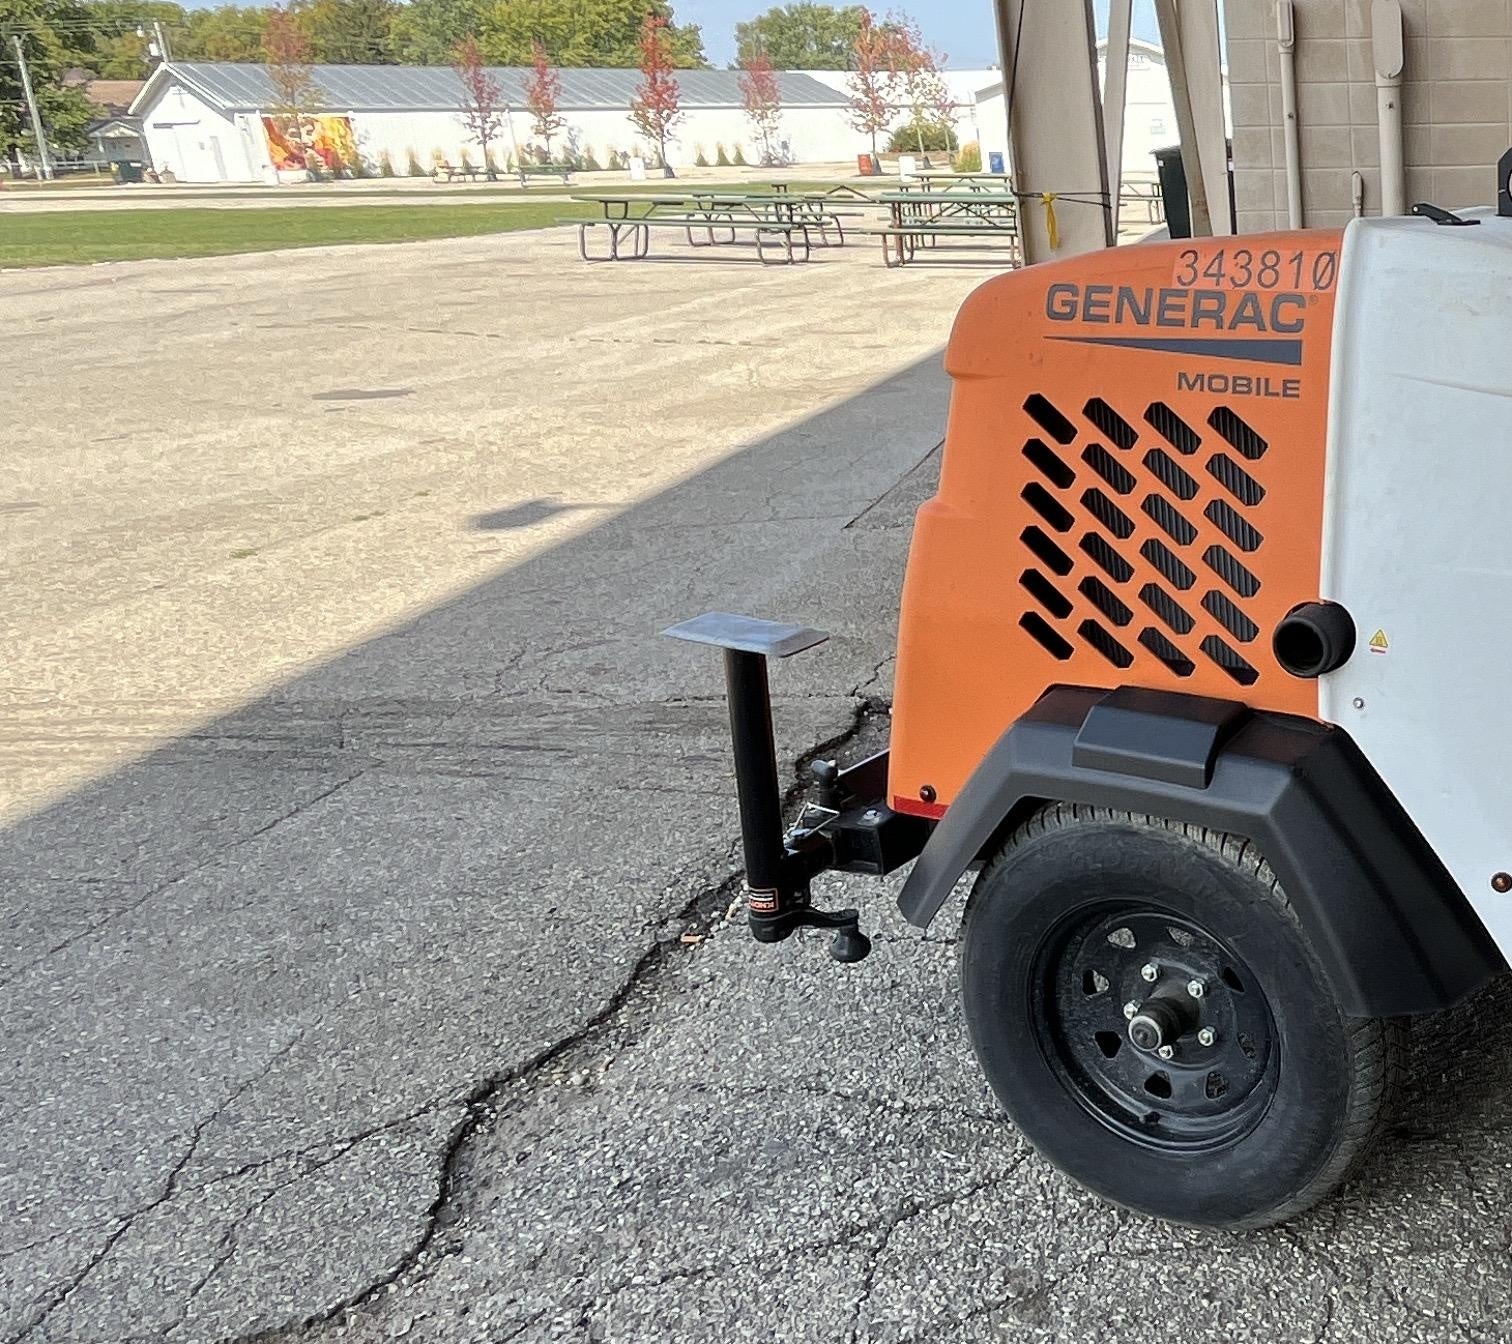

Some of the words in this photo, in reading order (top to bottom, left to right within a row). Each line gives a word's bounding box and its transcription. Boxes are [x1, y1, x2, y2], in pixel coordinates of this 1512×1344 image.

[1177, 249, 1339, 291] 343810
[1046, 283, 1305, 333] GENERAC
[1177, 372, 1301, 398] MOBILE
